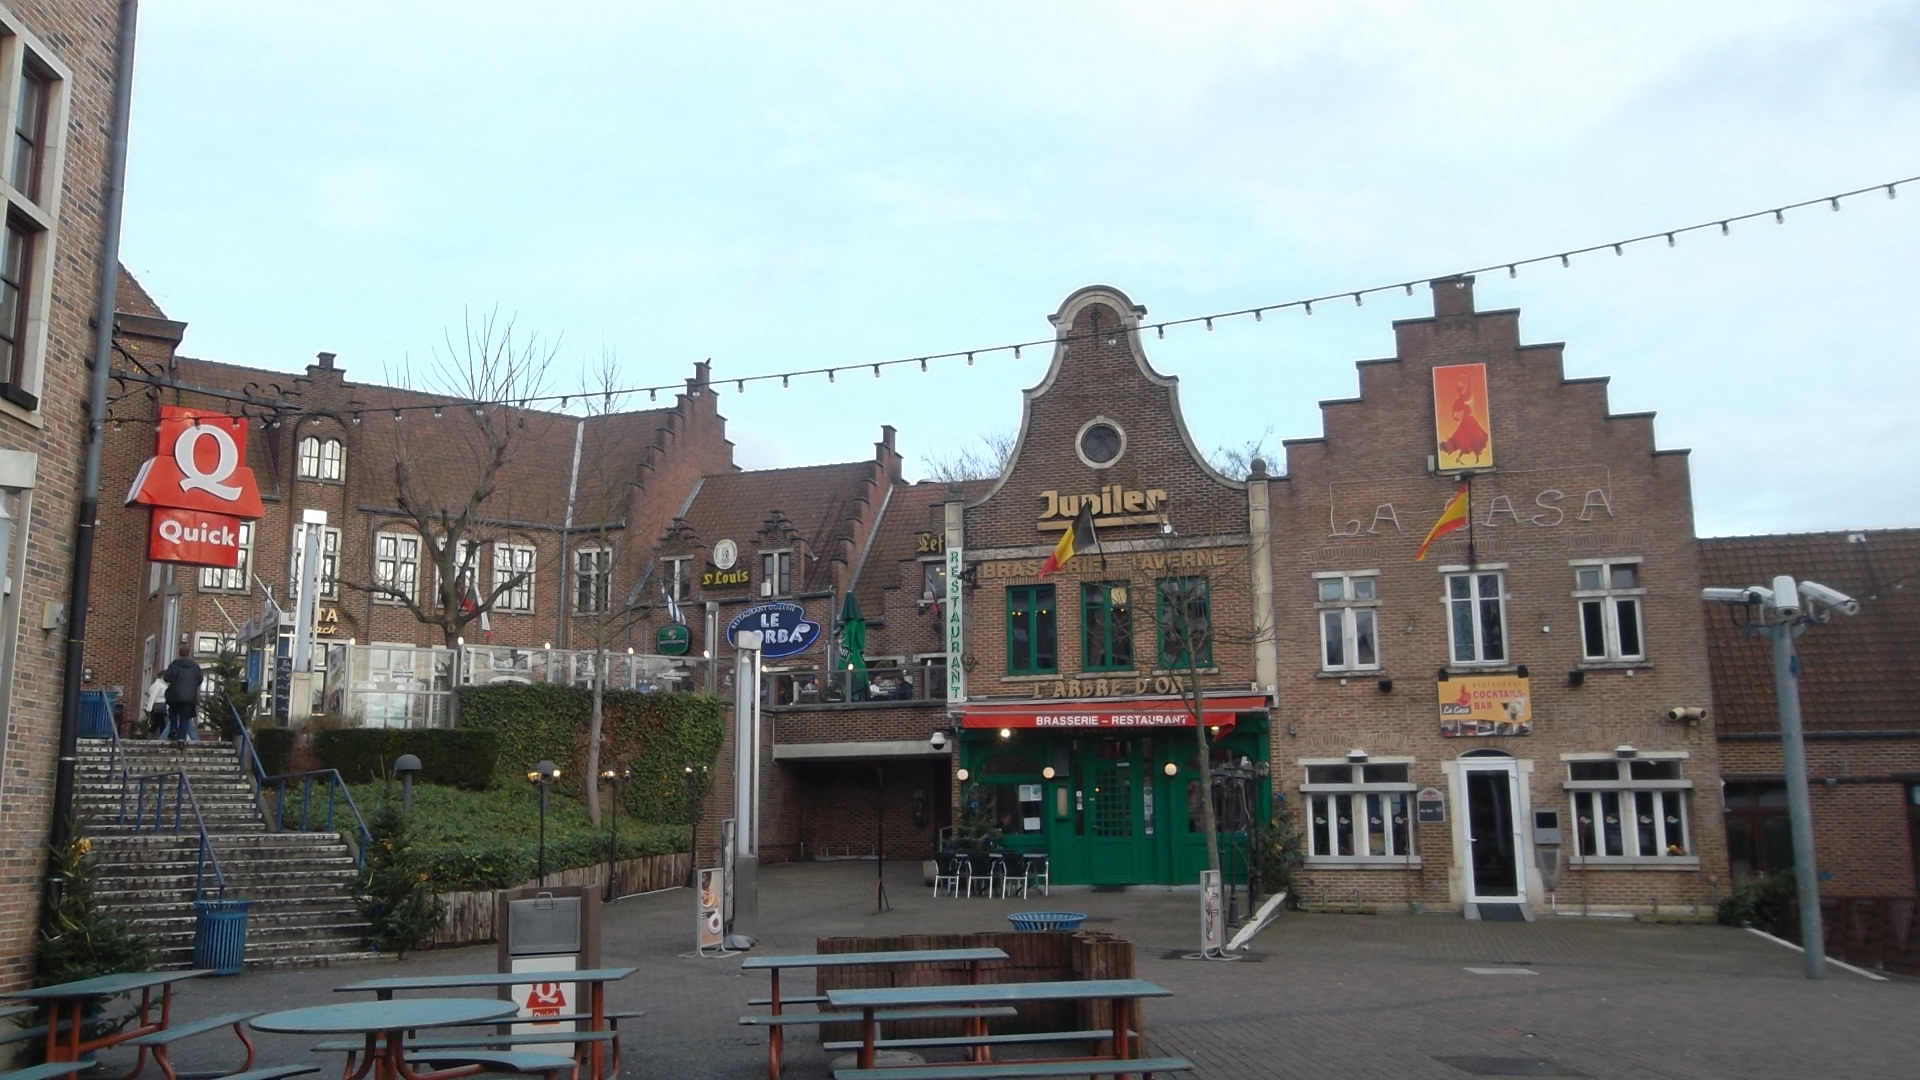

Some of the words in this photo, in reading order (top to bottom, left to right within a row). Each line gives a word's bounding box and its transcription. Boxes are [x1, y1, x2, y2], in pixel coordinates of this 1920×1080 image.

[175, 424, 243, 501] Q
[1038, 484, 1168, 519] Jupiler
[159, 519, 235, 547] Quick
[917, 532, 945, 554] Lef
[983, 557, 1102, 579] BRASRIE
[730, 605, 767, 630] RESTAURANT
[760, 612, 780, 628] LE
[951, 551, 961, 699] RESTAURANT
[1443, 705, 1453, 714] La
[1453, 705, 1469, 714] Casa
[1474, 702, 1493, 711] BAR
[1036, 715, 1098, 726] BRASSERIE
[1111, 714, 1189, 726] RESTAURANT
